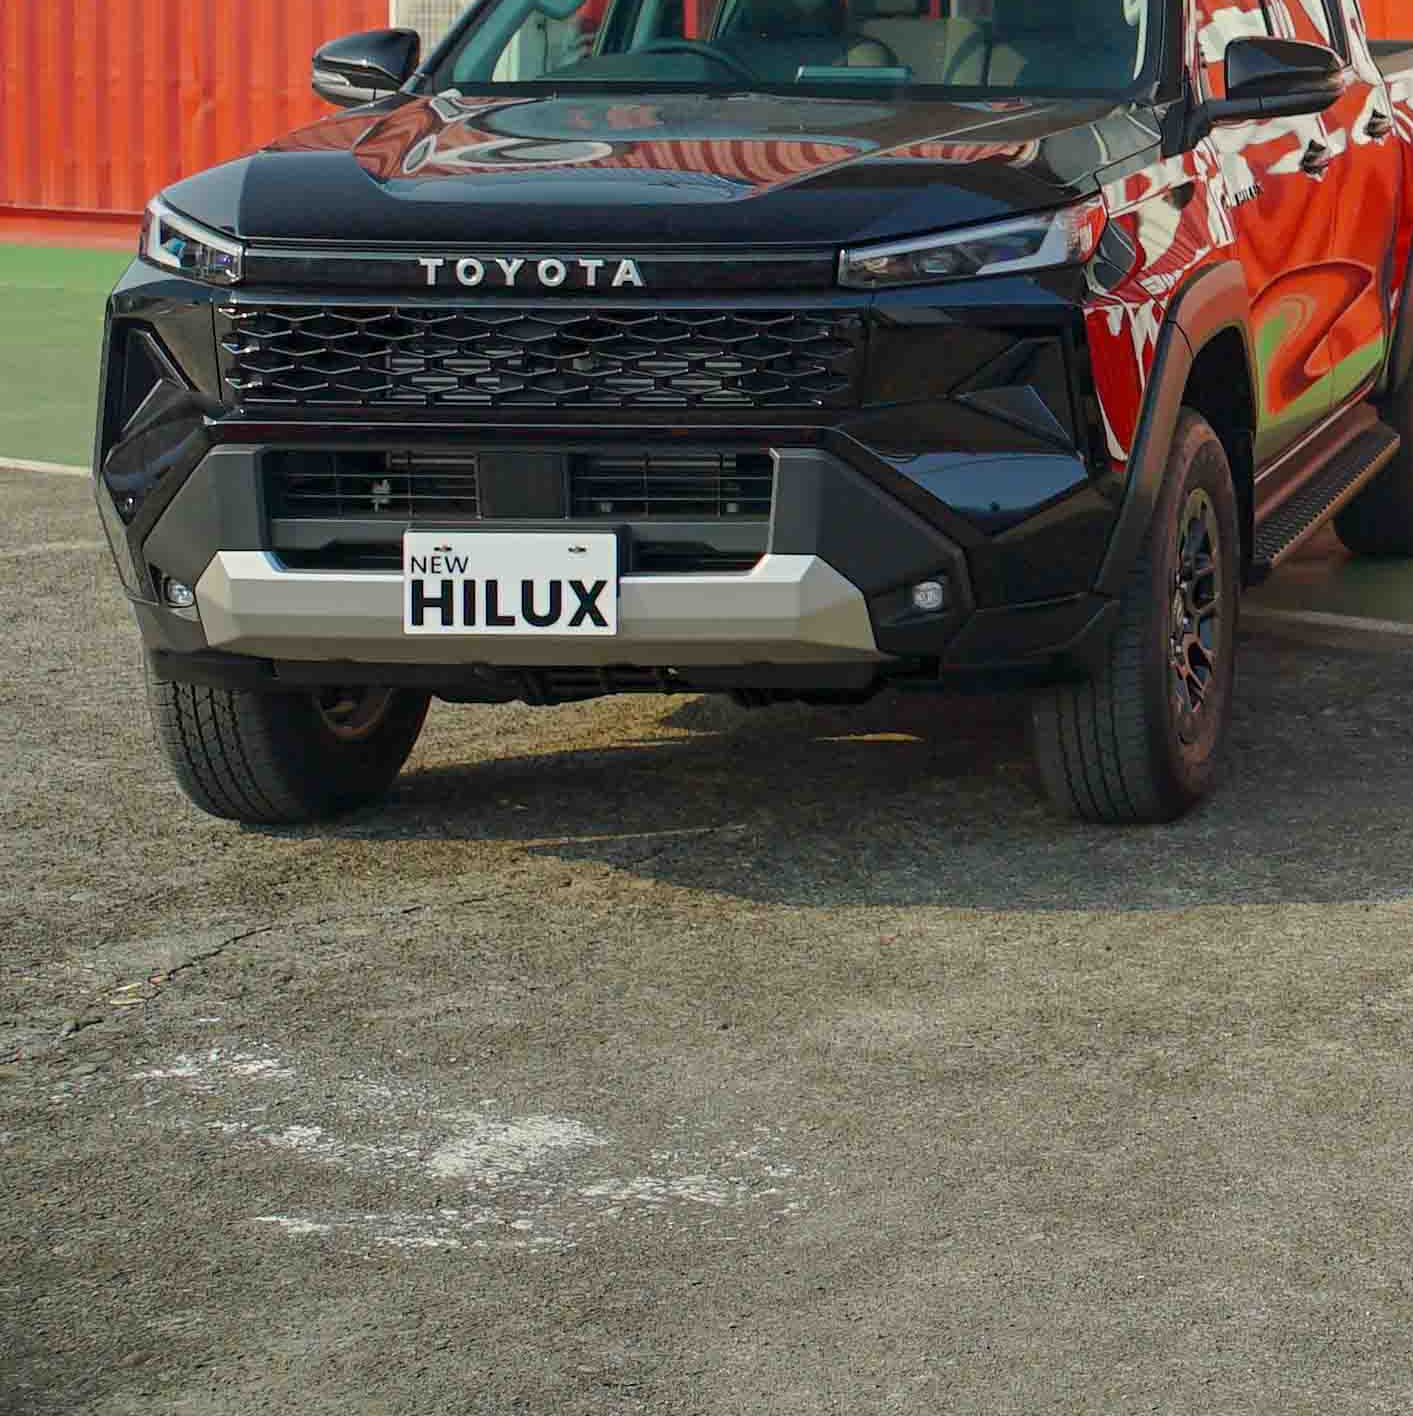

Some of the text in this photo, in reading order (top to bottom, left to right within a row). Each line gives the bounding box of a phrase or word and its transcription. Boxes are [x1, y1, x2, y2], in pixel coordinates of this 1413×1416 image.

[418, 256, 646, 287] TOYOTA
[410, 555, 469, 574] NEW
[411, 579, 609, 627] HILUX
